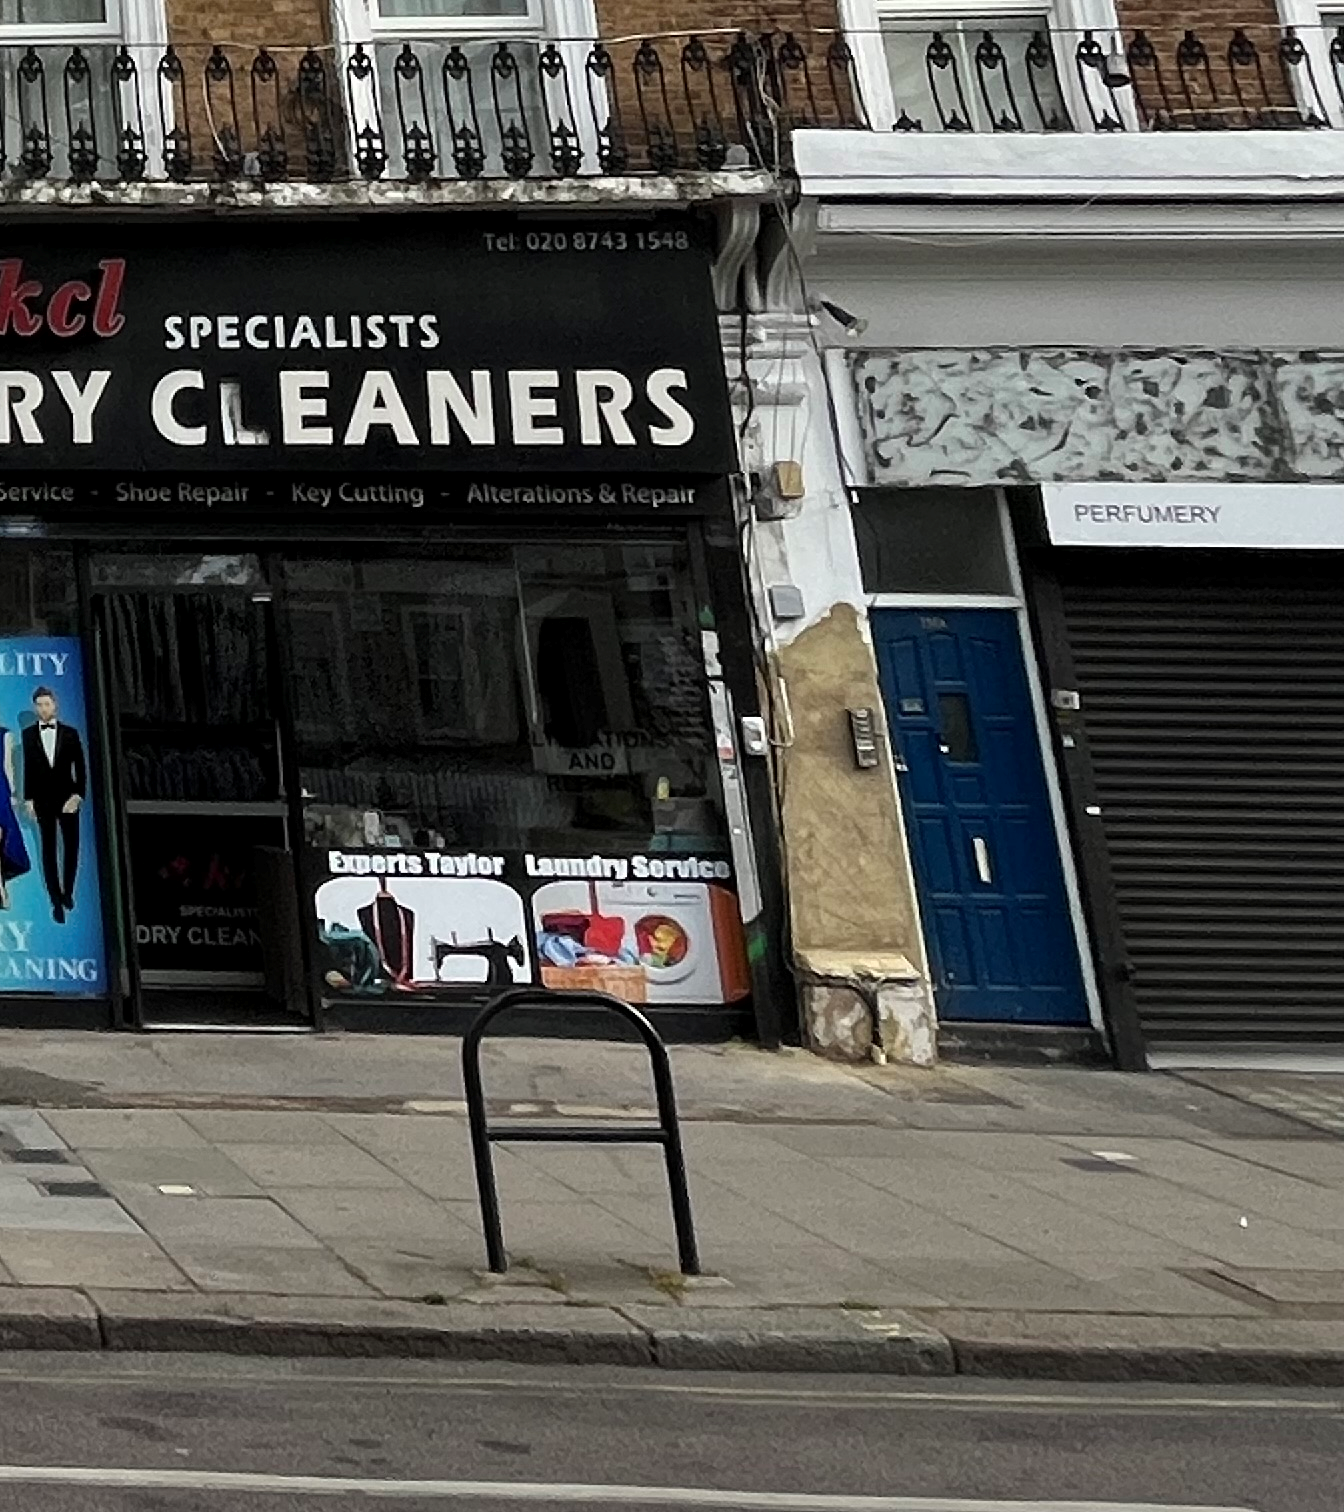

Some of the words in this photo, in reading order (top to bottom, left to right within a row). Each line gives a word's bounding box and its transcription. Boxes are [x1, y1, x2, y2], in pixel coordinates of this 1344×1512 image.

[526, 232, 567, 251] 020
[573, 231, 628, 250] 8743
[636, 231, 690, 250] 1548
[164, 313, 441, 350] SPECIALISTS
[150, 368, 696, 448] CLEANERS
[116, 482, 172, 502] Shoe
[178, 482, 250, 507] Repair
[292, 482, 332, 507] Key
[338, 482, 424, 508] Cutting
[467, 482, 593, 504] Alterations
[598, 483, 617, 504] &
[622, 483, 696, 508] Repair
[1074, 504, 1222, 524] PERFUMERY
[569, 752, 616, 770] AND
[328, 850, 423, 876] Experts
[425, 851, 505, 877] Taylor
[524, 853, 628, 880] Laundry
[632, 853, 730, 879] Service
[136, 924, 181, 945] DRY
[187, 926, 262, 947] CLEAN
